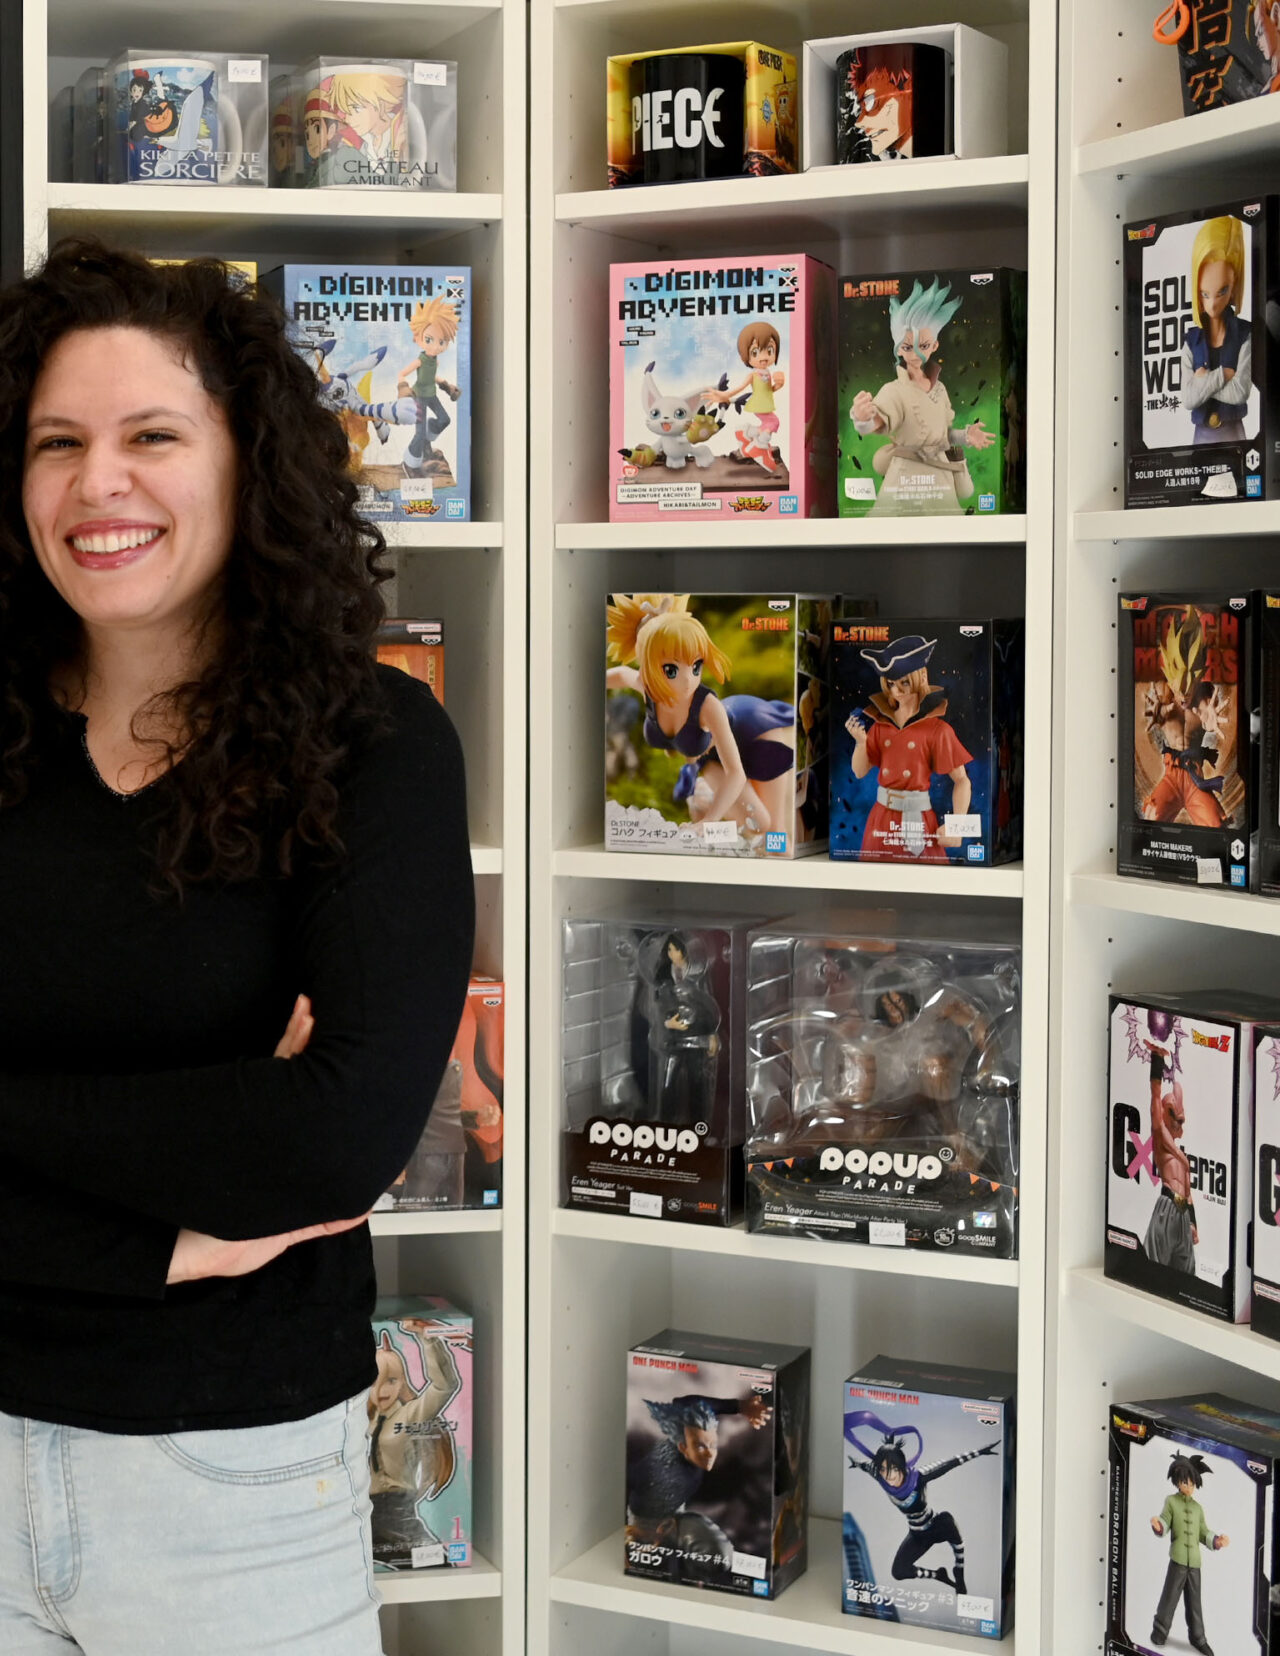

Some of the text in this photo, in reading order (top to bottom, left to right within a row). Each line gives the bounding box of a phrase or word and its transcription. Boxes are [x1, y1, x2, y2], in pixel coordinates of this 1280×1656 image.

[344, 158, 438, 175] CHÂTEAU
[348, 176, 432, 186] AMBULANT
[844, 280, 900, 298] Dr.STONE
[619, 292, 795, 322] ADVENTURE
[901, 475, 935, 485] Dr.STONE
[1135, 469, 1172, 480] SOLID EDGE
[742, 618, 789, 631] Dr.STONE
[834, 626, 889, 642] Dr.STONE
[611, 828, 677, 838] コハク フィギュア
[890, 821, 925, 831] Dr.STONE
[1150, 841, 1193, 853] MATCH MAKERS
[589, 1121, 699, 1154] POPUP
[610, 1149, 676, 1167] PARADE
[820, 1147, 942, 1180] POPUP
[572, 1176, 616, 1190] Eren Yeager
[842, 1176, 915, 1194] PARADE
[698, 1202, 718, 1210] SMILE
[764, 1202, 783, 1212] Eren
[786, 1203, 813, 1215] Yeager
[649, 1358, 676, 1370] PUNCH
[393, 1420, 458, 1435] チェンソーマン
[453, 1517, 462, 1539] 1
[1111, 1512, 1120, 1564] DRAGON
[628, 1551, 662, 1566] ガロウ
[676, 1549, 711, 1562] フィギュア
[713, 1556, 729, 1567] #4
[846, 1589, 929, 1612] 音速のソニック
[897, 1587, 936, 1601] フィギュア
[938, 1594, 954, 1605] #3
